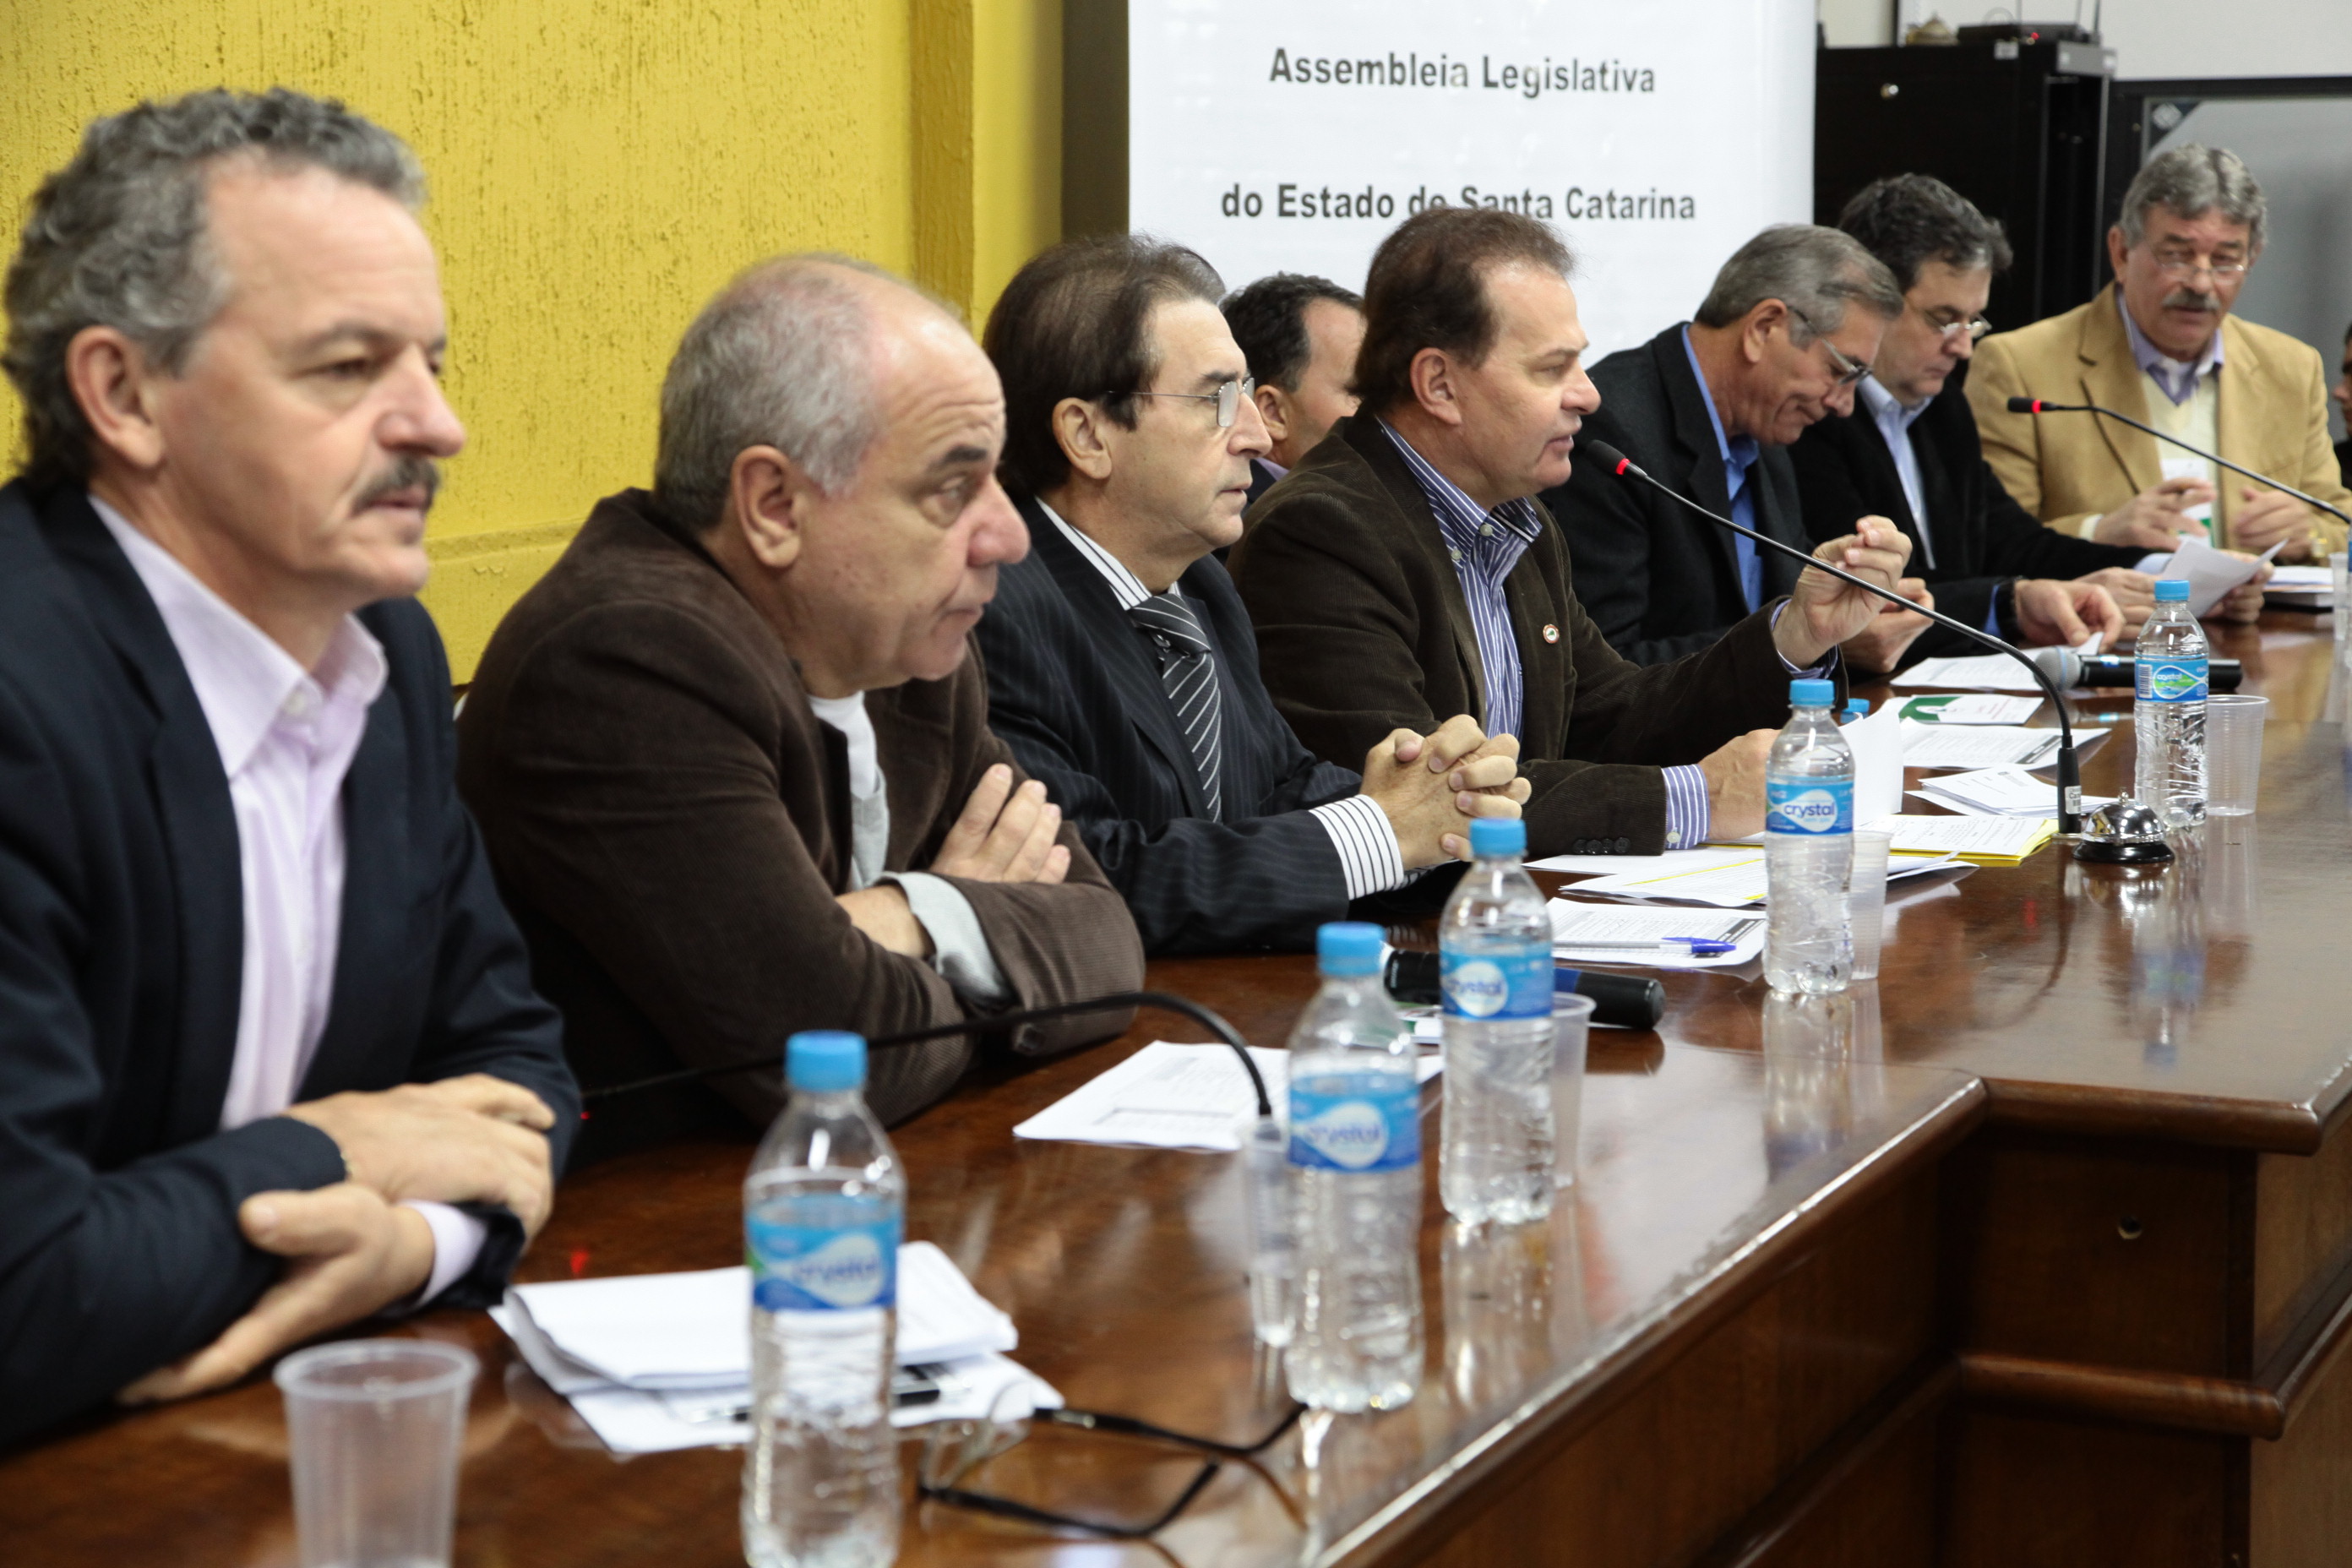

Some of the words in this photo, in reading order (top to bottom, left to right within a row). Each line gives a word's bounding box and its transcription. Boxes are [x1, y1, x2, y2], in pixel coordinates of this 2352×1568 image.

[1270, 47, 1468, 88] Assembleia
[1483, 55, 1655, 98] Legislativa
[1222, 183, 1263, 217] do
[1277, 183, 1395, 218] Estado
[1565, 188, 1696, 219] Catarina
[1783, 800, 1835, 818] crystal
